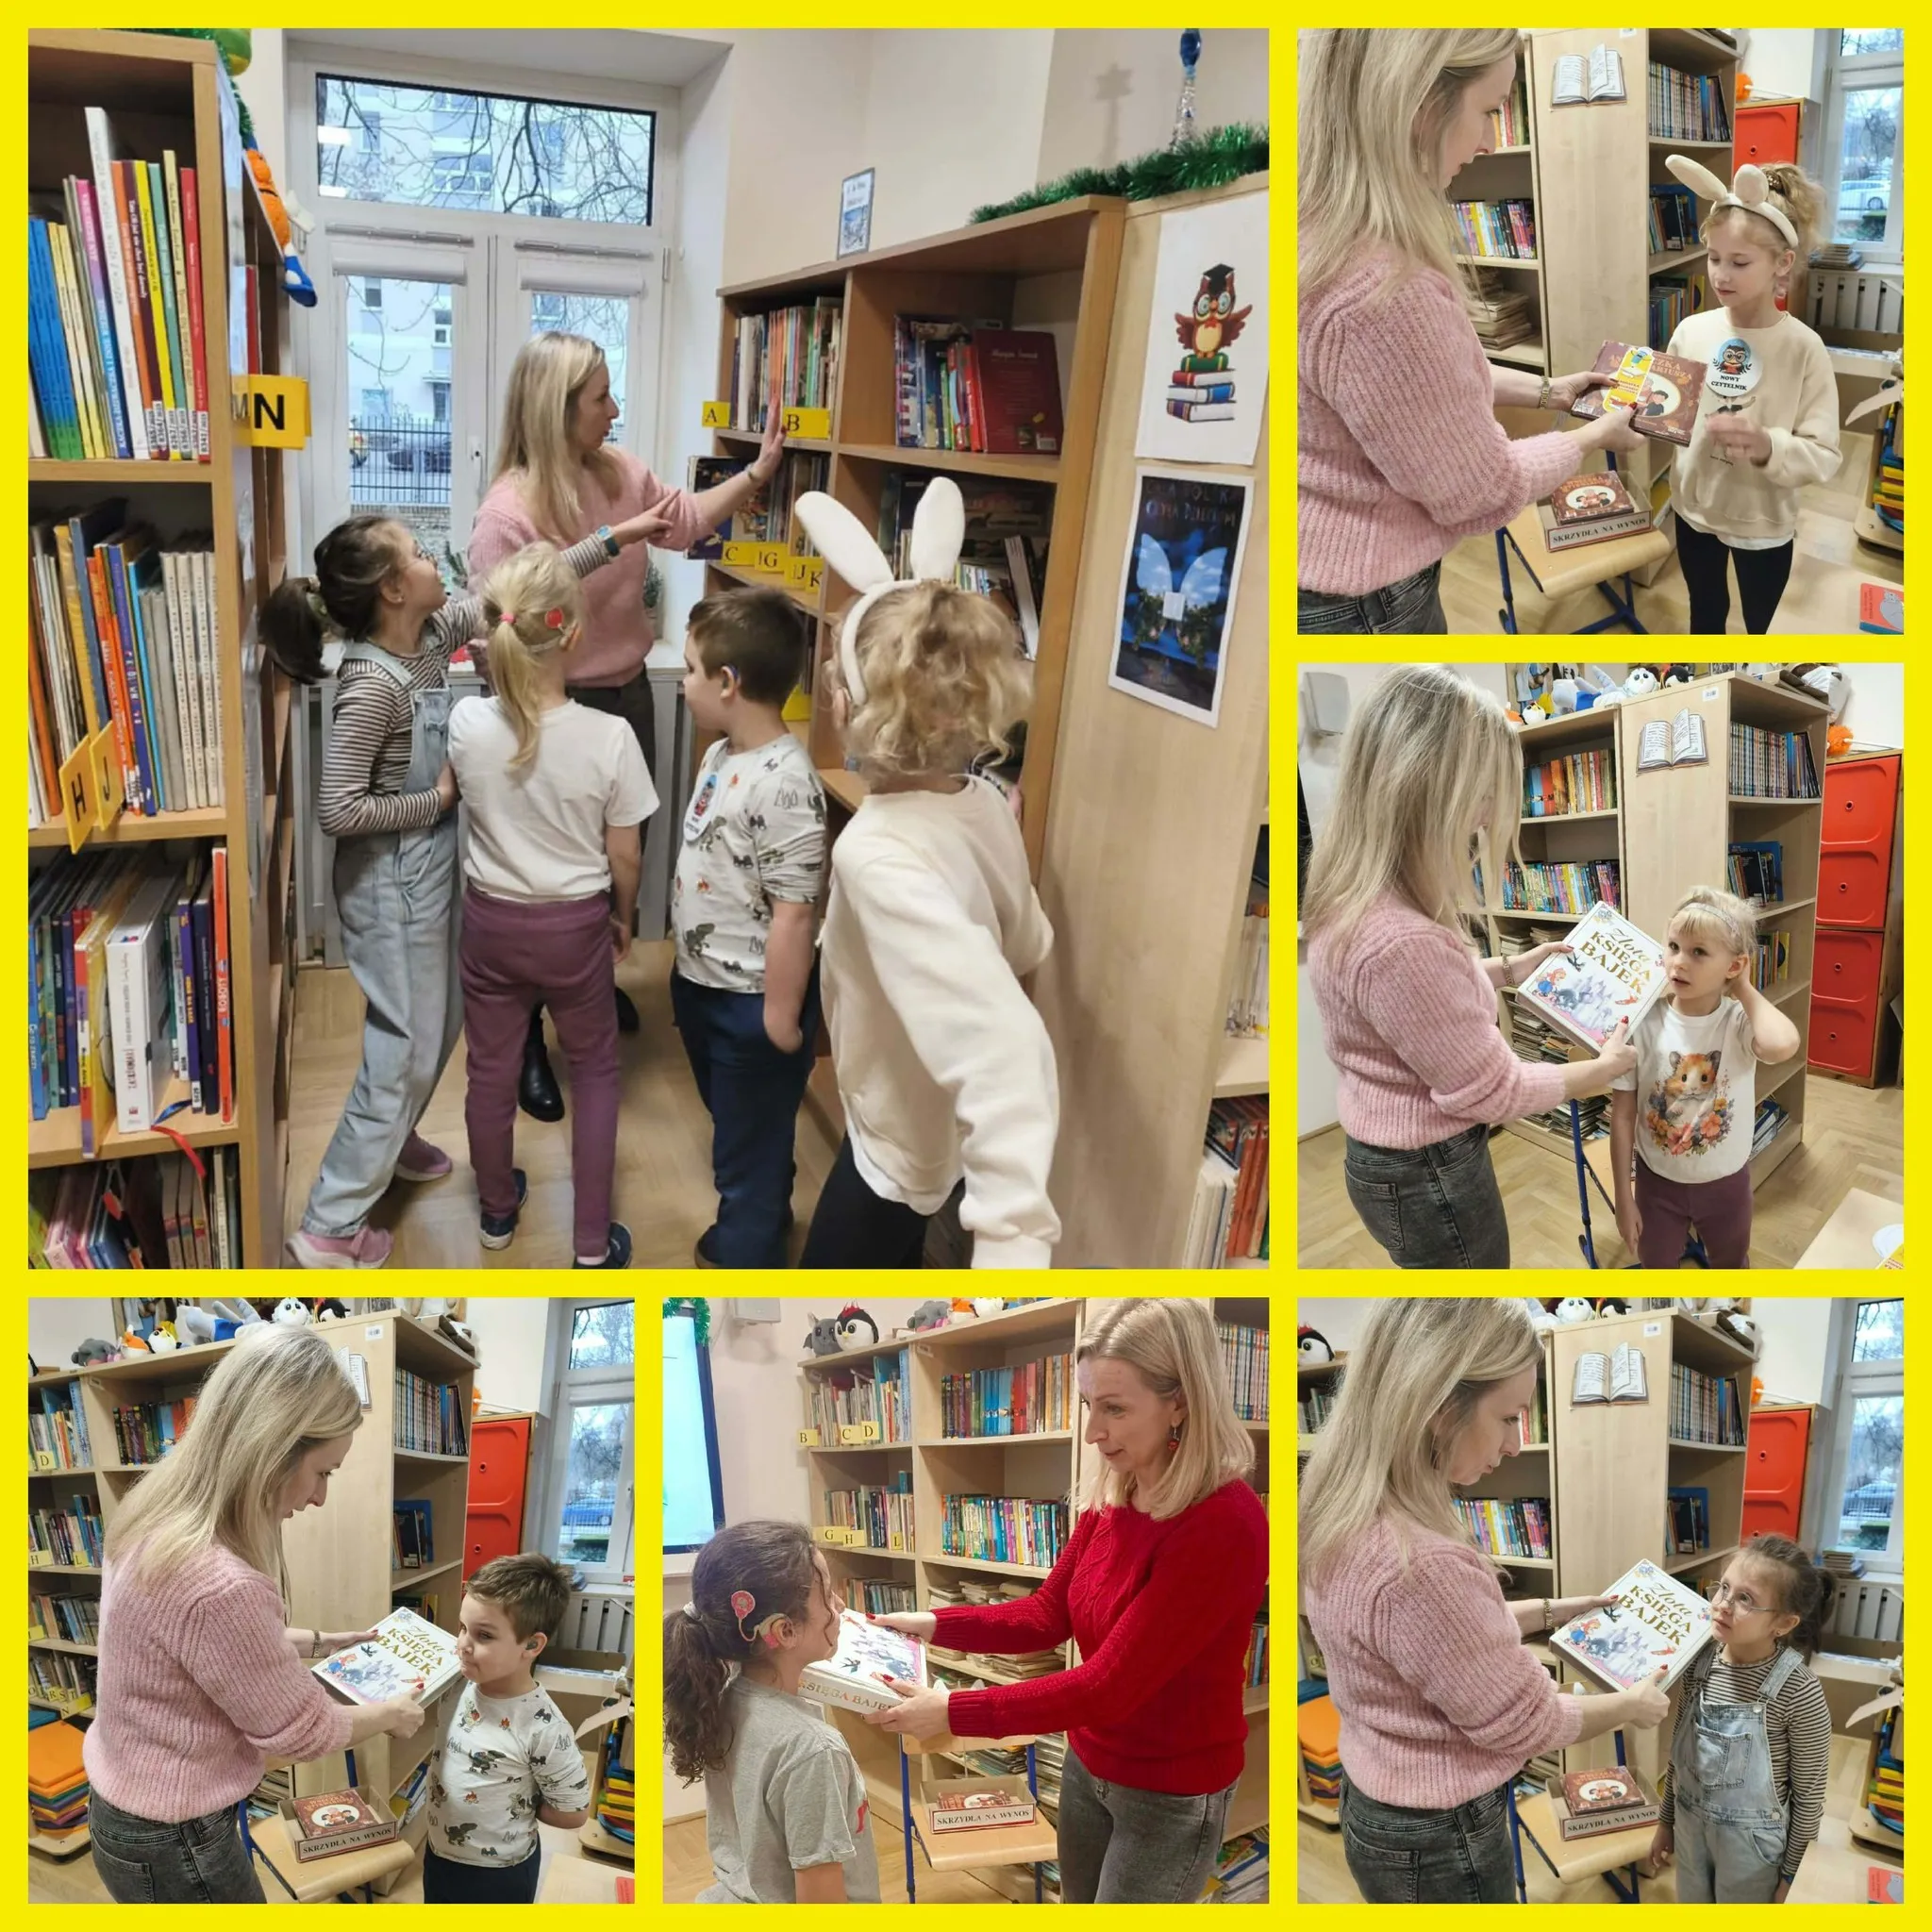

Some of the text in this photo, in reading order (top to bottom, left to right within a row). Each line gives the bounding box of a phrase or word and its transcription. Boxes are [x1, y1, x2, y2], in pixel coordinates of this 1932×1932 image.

[1710, 380, 1747, 391] CZYTELNIK
[254, 392, 285, 430] N
[705, 408, 718, 424] A
[786, 413, 800, 432] B
[725, 546, 738, 561] C
[764, 551, 777, 567] G
[797, 564, 806, 579] J
[809, 572, 823, 587] K
[101, 757, 110, 802] J
[72, 772, 86, 823] H
[1590, 930, 1651, 982] KSIĘGA
[1579, 941, 1645, 994] BAJEK
[800, 1433, 808, 1442] B
[842, 1429, 851, 1440] C
[864, 1425, 874, 1437] D
[40, 1455, 49, 1466] D
[824, 1529, 834, 1541] G
[845, 1534, 853, 1544] H
[894, 1537, 900, 1546] L
[30, 1555, 39, 1565] H
[75, 1555, 82, 1564] L
[1630, 1585, 1691, 1634] KSIĘGA
[1618, 1594, 1687, 1645] BAJEK
[387, 1627, 443, 1666] KSIĘGA
[375, 1634, 437, 1675] BAJEK
[364, 1828, 392, 1840] WYNOS
